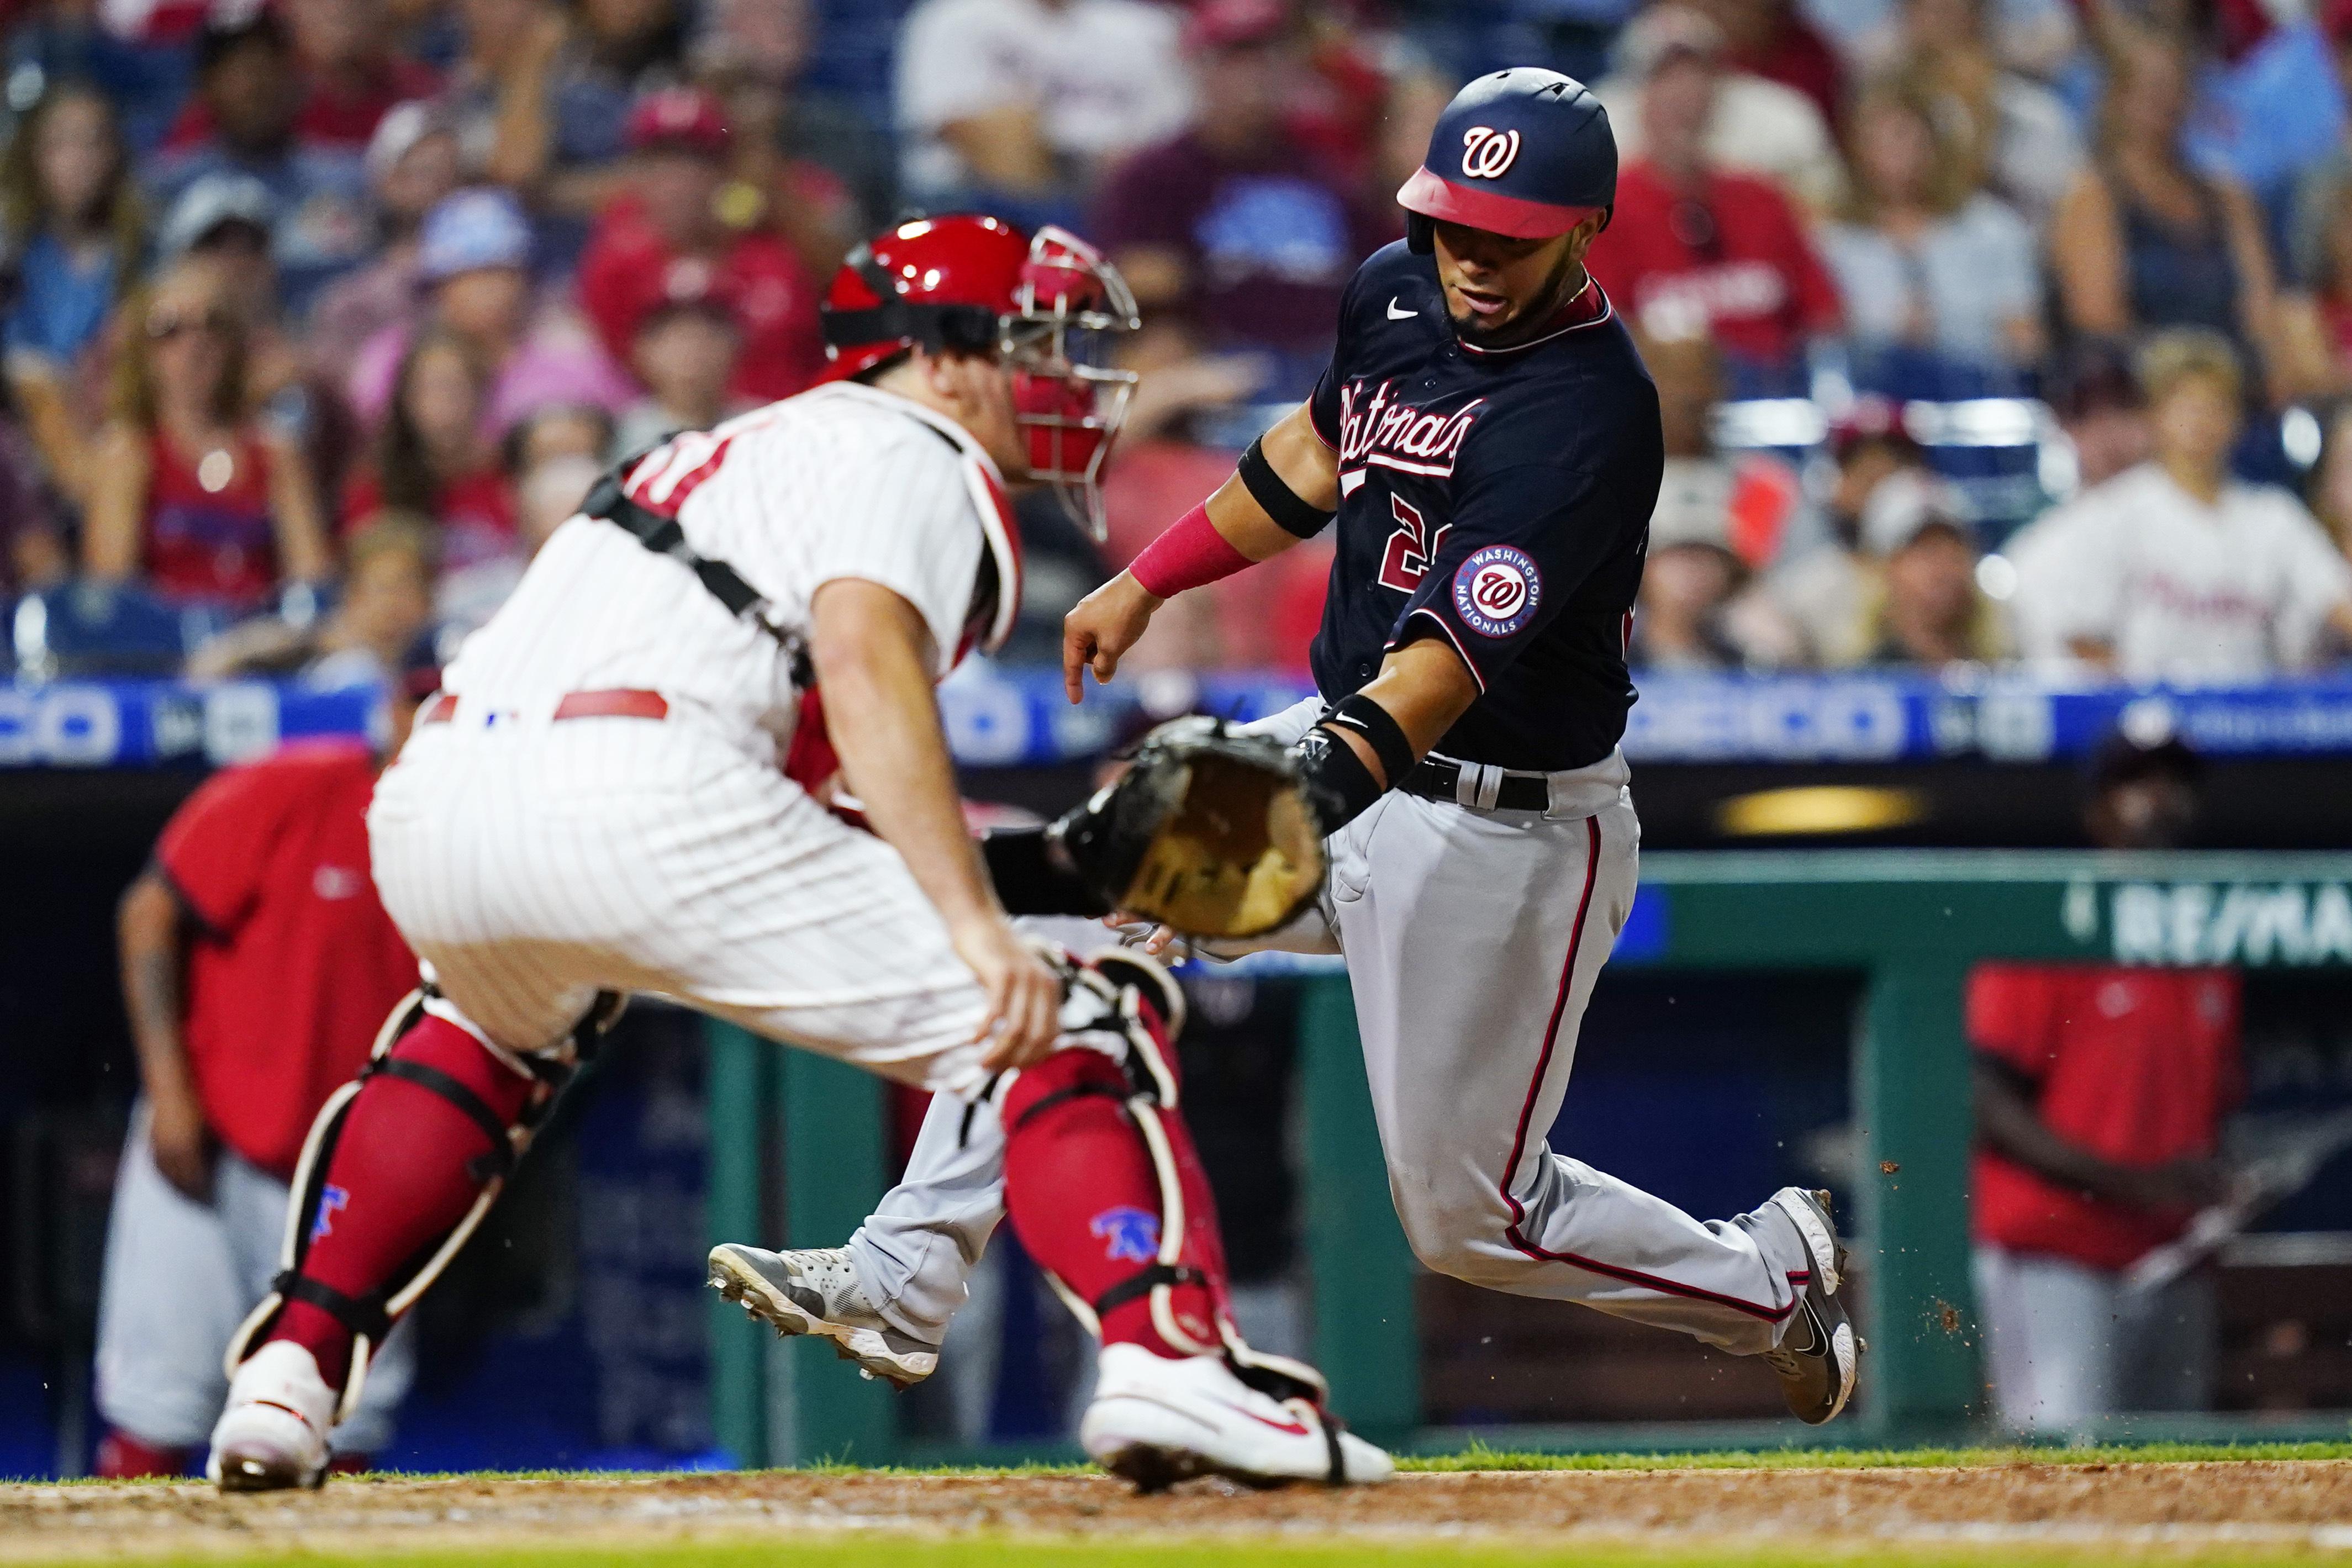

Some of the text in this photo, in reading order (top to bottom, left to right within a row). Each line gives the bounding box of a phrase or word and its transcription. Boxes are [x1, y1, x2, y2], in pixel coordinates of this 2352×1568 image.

[1462, 126, 1520, 178] W
[1378, 491, 1454, 595] 2
[1472, 549, 1539, 606] WASHINGTON
[1478, 572, 1522, 610] W
[1457, 585, 1516, 636] NATIONALS
